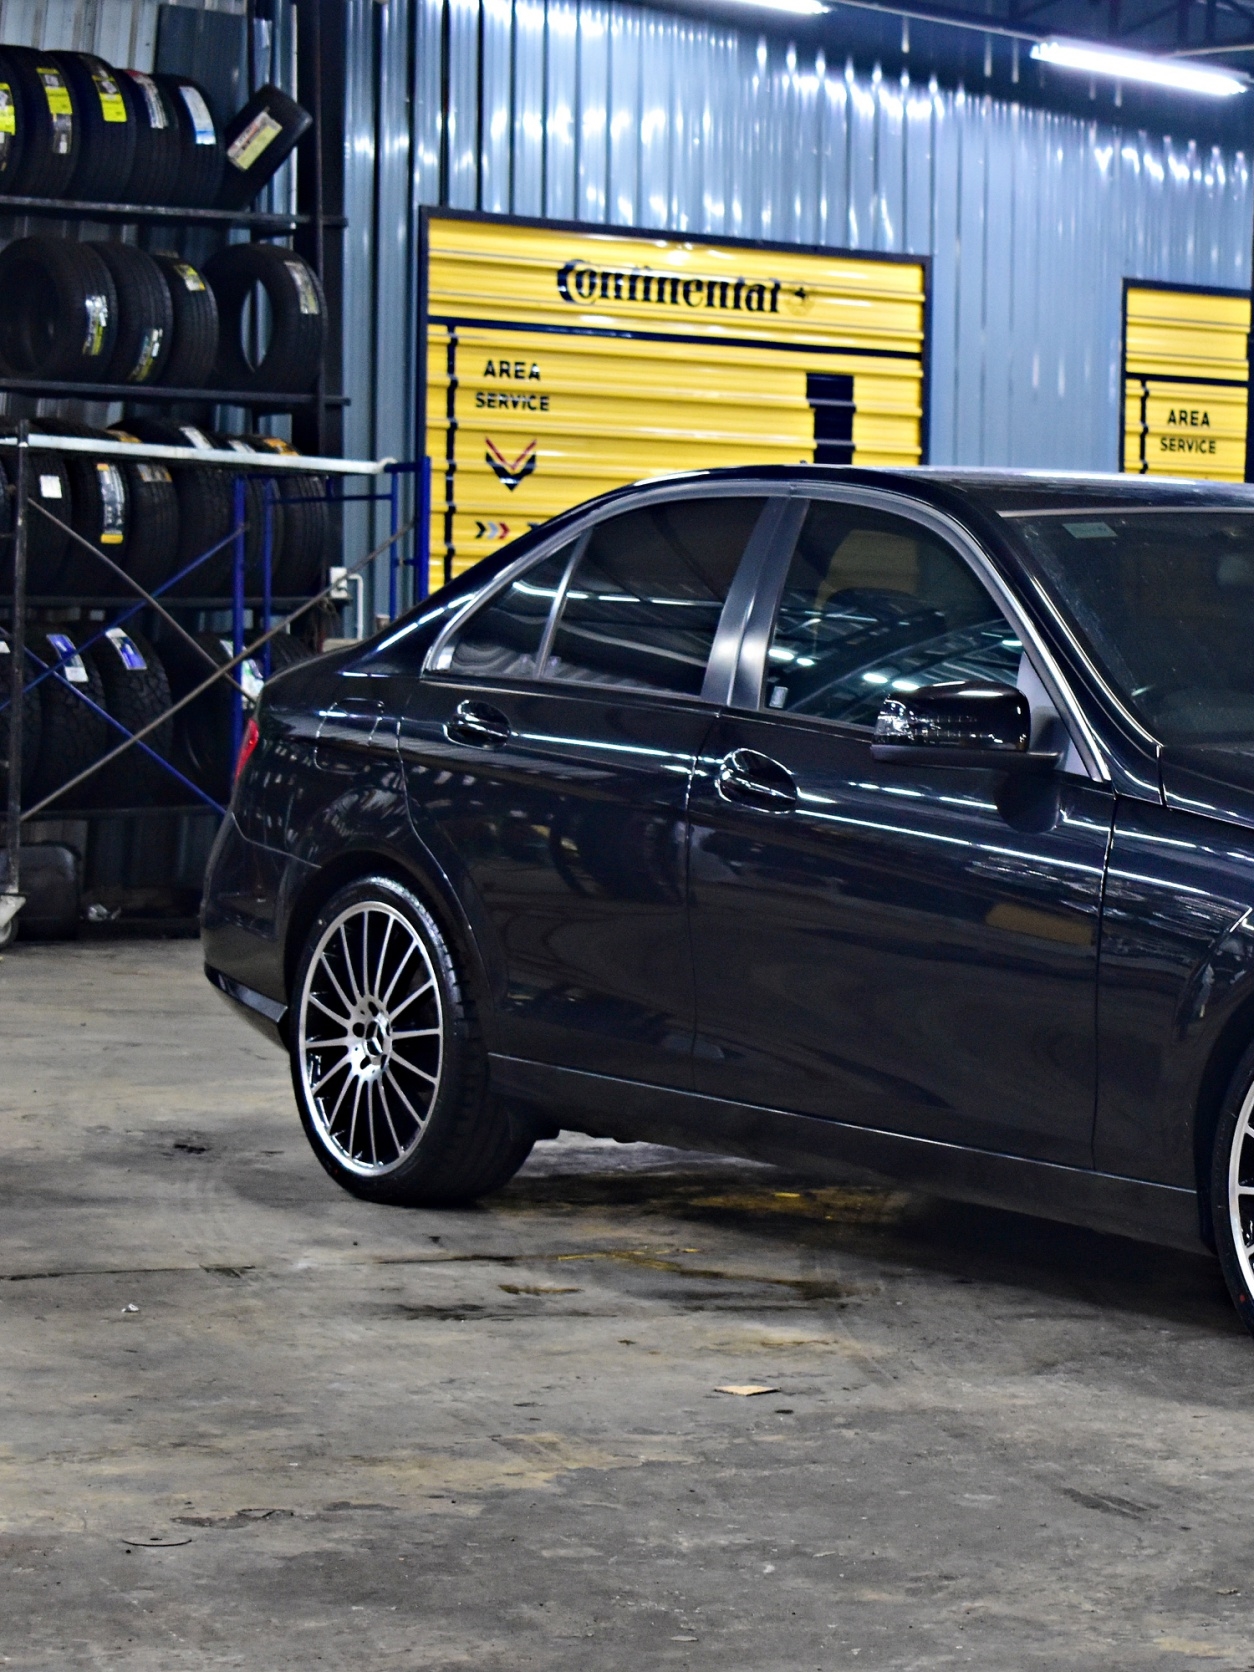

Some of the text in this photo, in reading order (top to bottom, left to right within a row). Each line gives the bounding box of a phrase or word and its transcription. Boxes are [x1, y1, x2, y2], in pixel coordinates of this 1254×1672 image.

[557, 259, 781, 314] Continental
[483, 359, 541, 381] AREA
[475, 391, 550, 412] SERVICE
[1166, 408, 1211, 428] AREA
[1160, 436, 1217, 455] SERVICE
